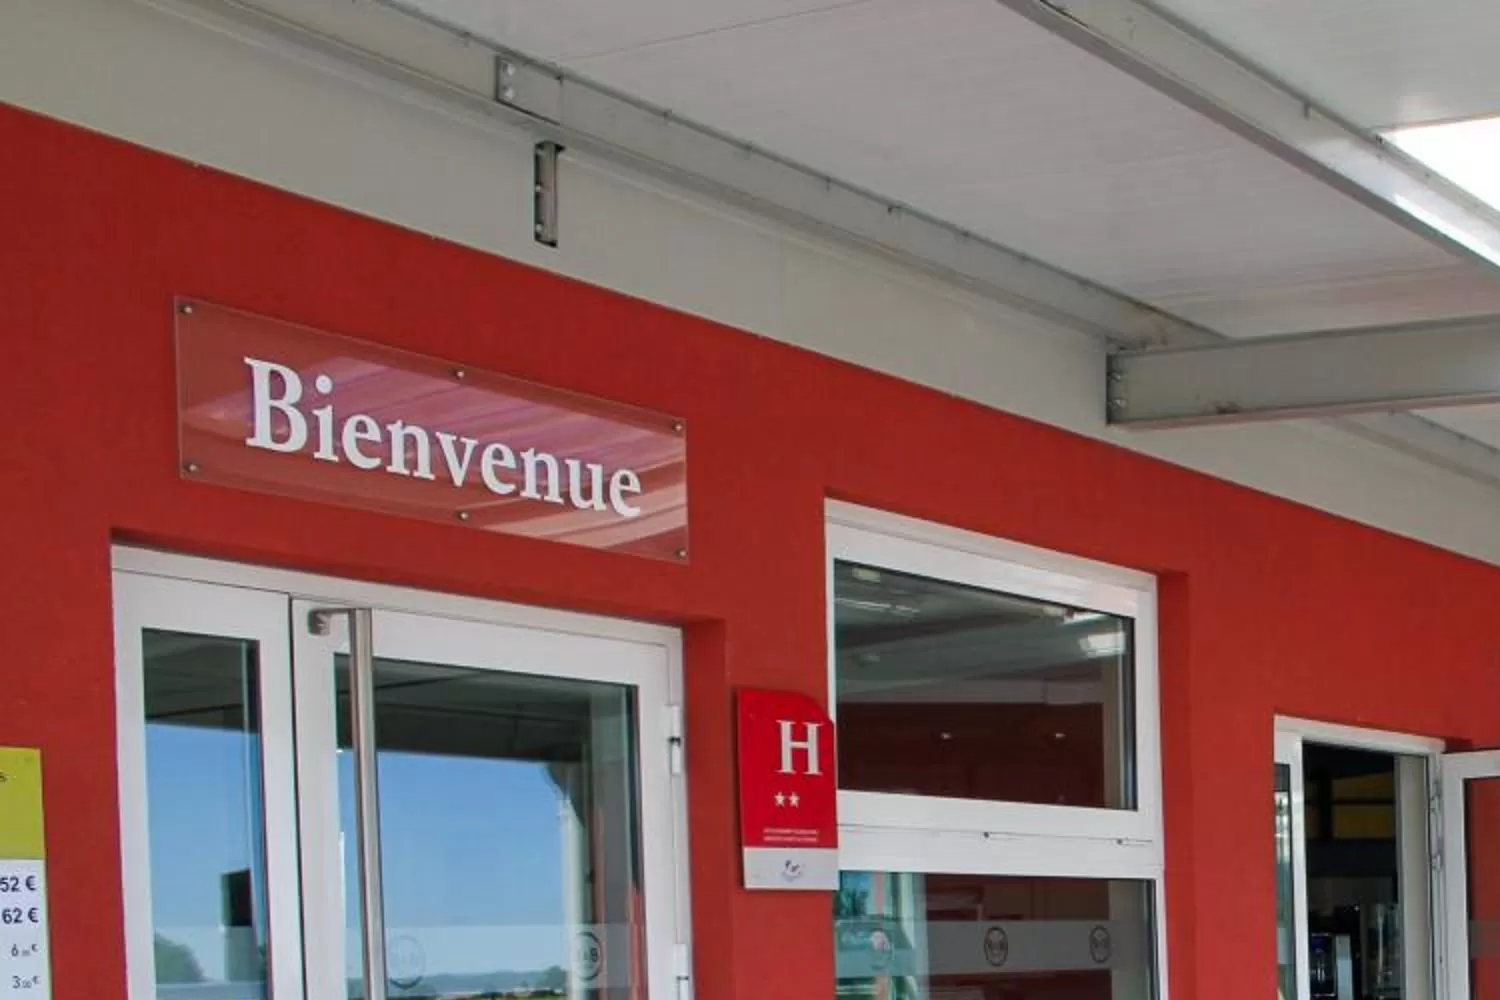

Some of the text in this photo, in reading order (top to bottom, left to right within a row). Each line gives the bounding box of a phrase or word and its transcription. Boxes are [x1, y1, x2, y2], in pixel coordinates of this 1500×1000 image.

[243, 357, 642, 518] Bienvenue
[776, 719, 823, 775] H
[2, 907, 23, 924] 62
